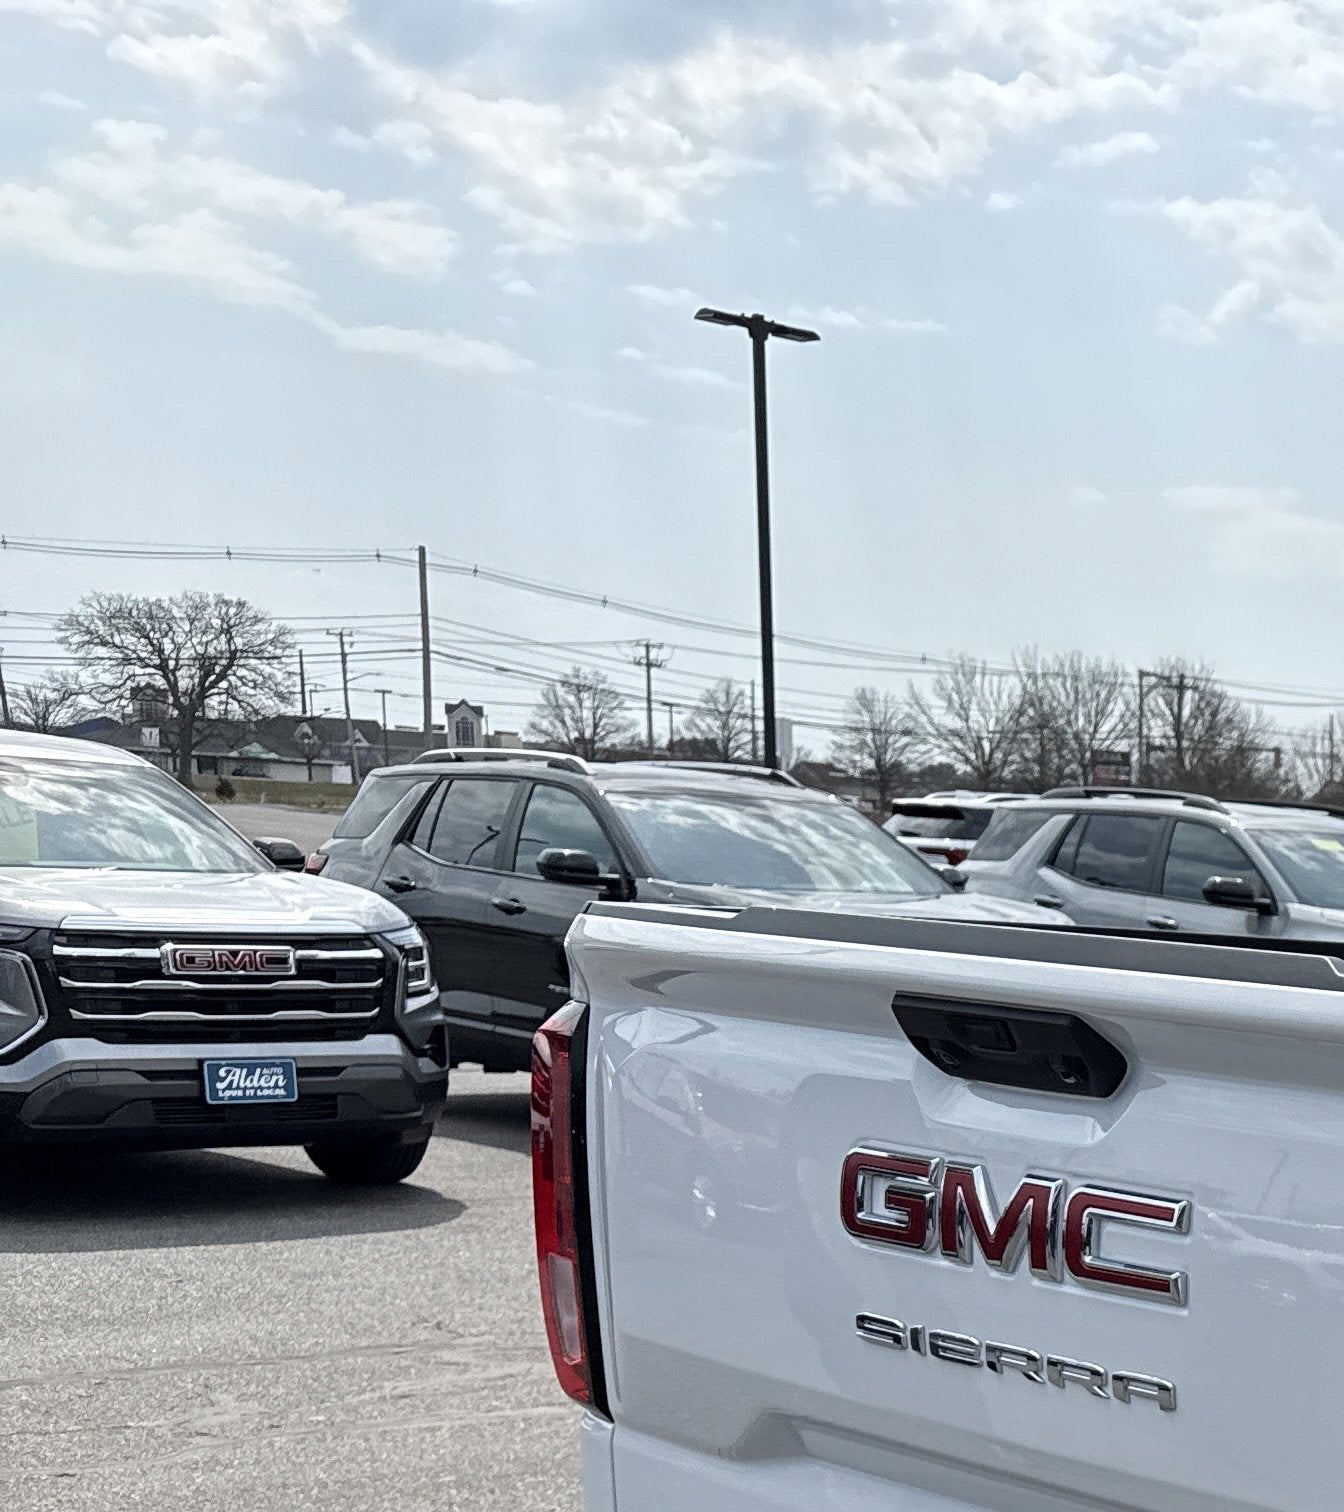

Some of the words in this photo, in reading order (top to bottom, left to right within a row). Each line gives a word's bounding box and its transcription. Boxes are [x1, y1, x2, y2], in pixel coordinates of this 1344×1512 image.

[176, 950, 290, 971] GMC
[216, 1066, 287, 1090] Alden
[840, 1145, 1192, 1306] GMC
[855, 1311, 1177, 1412] SIERRA
